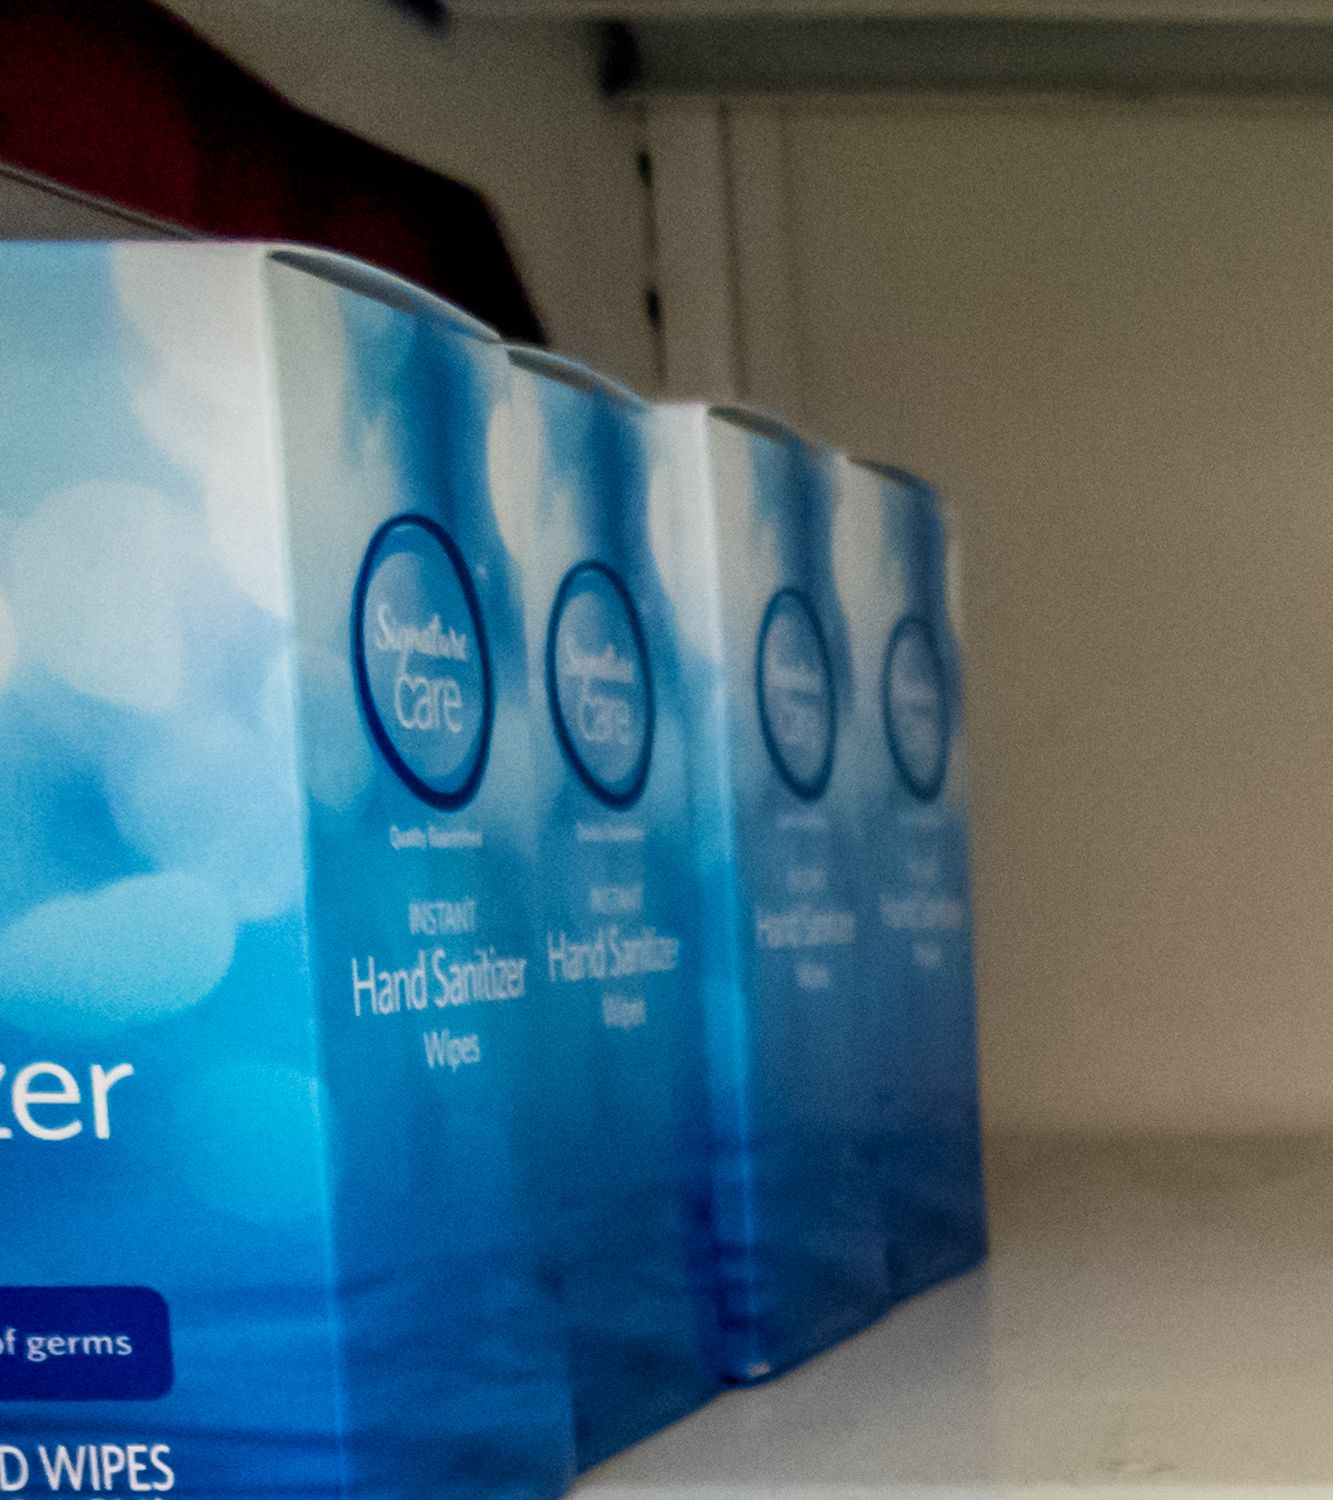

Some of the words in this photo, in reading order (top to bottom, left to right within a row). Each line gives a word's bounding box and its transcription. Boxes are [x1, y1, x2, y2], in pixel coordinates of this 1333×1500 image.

[395, 674, 463, 734] Care
[351, 949, 428, 1017] Hand
[430, 946, 528, 1008] Sanitizer
[422, 1030, 482, 1073] Wipes
[0, 1061, 135, 1141] er
[26, 1334, 133, 1362] germs
[39, 1444, 175, 1492] WIPES
